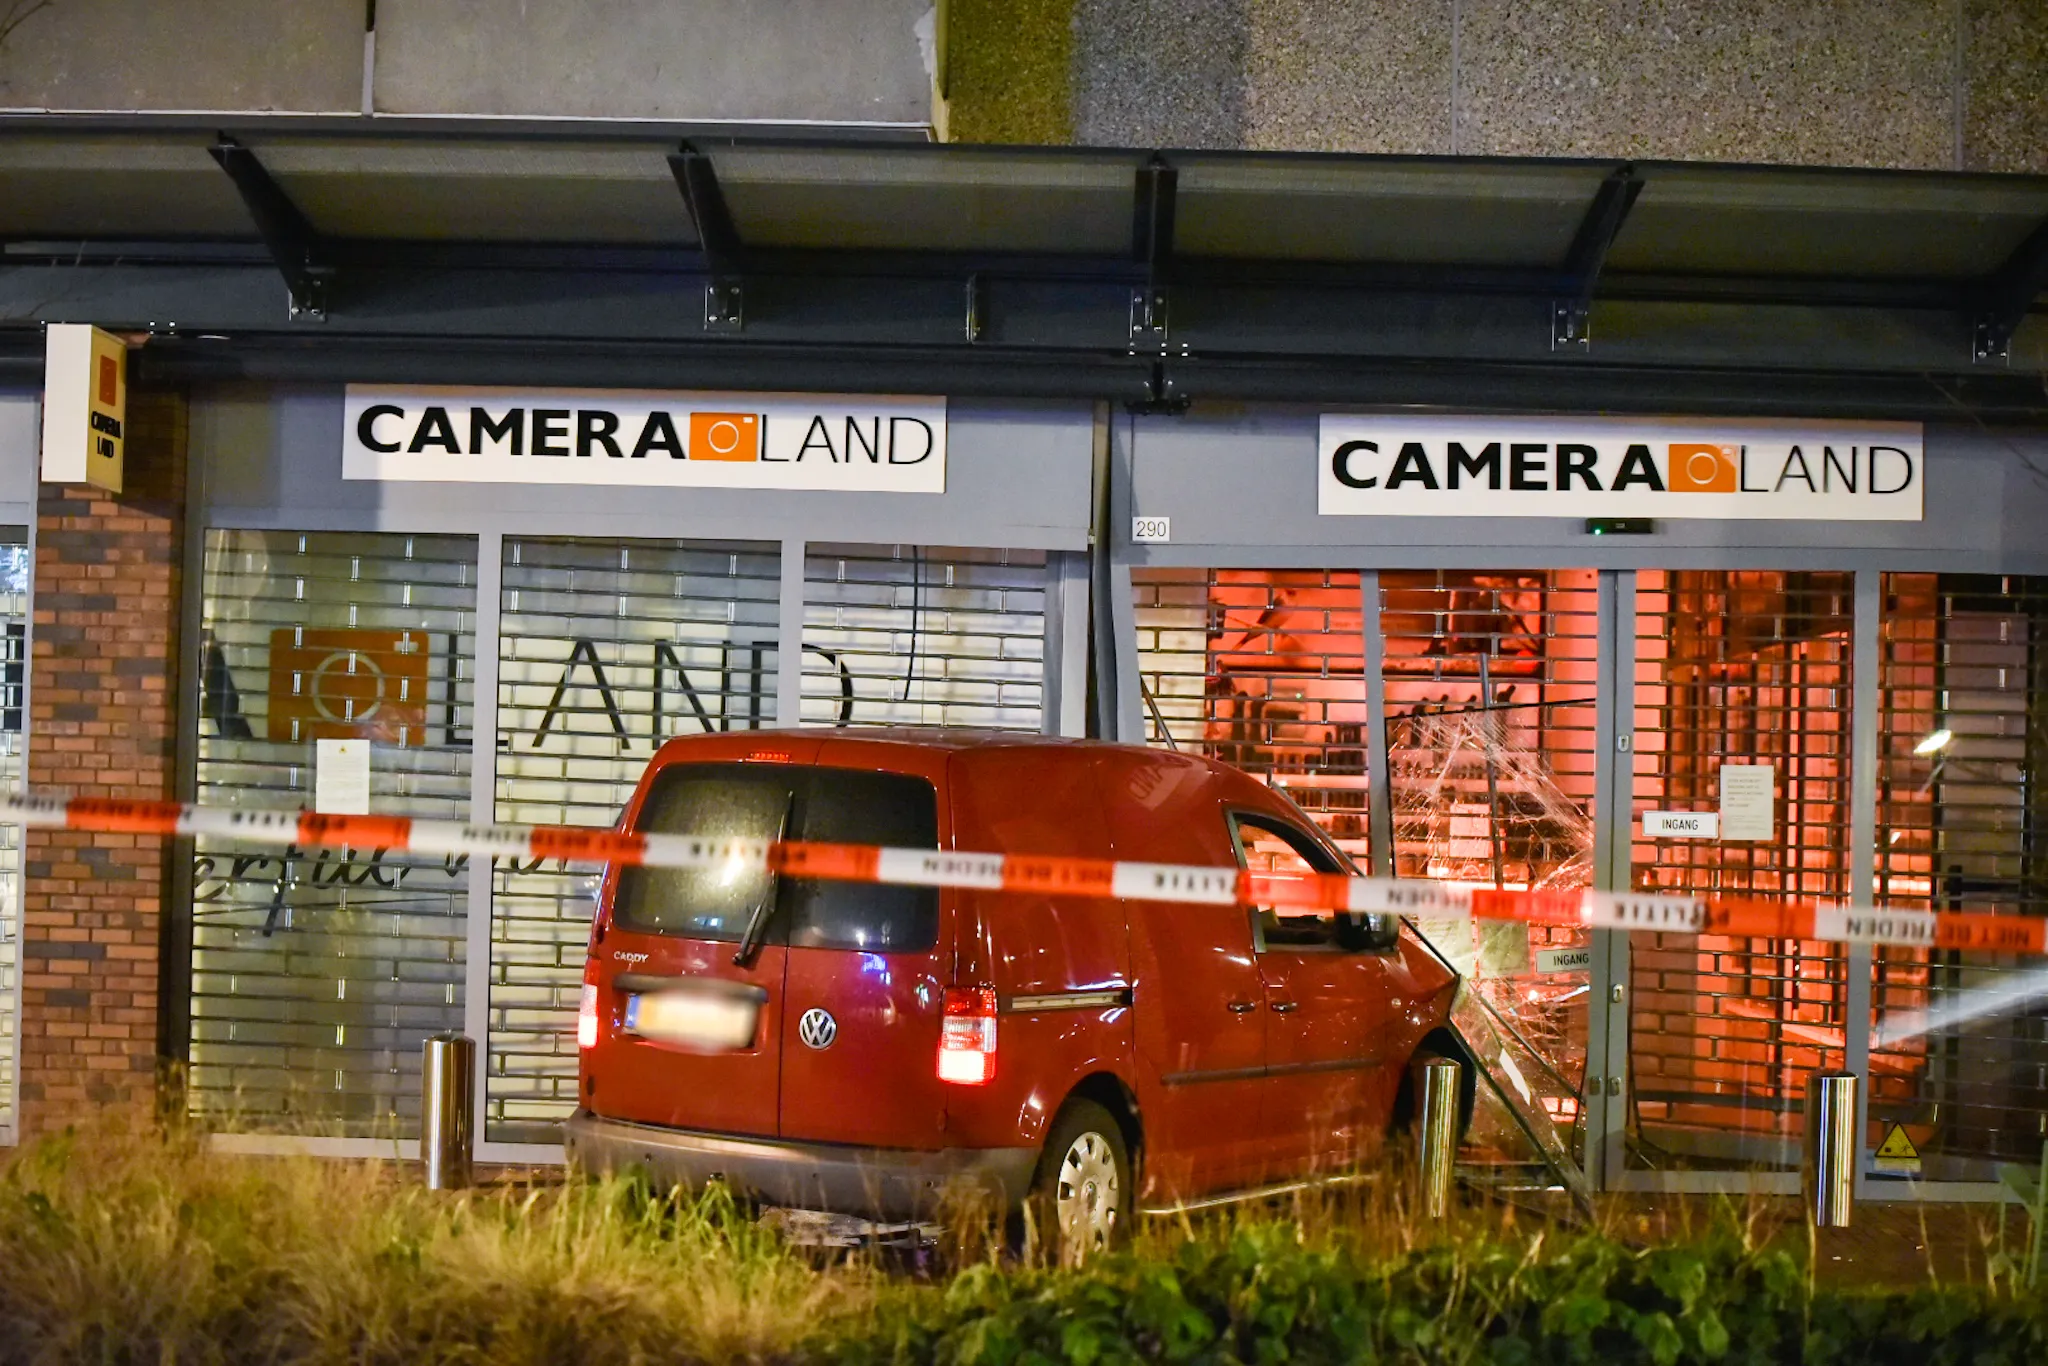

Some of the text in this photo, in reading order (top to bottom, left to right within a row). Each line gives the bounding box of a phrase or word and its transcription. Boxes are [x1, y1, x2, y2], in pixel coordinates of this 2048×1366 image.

[357, 404, 933, 465] CAMERA LAND
[1331, 440, 1914, 494] CAMERA LAND
[1136, 520, 1167, 537] 290
[1662, 819, 1699, 830] INGANG
[613, 951, 649, 963] CADDY
[1553, 953, 1589, 966] INGANG
